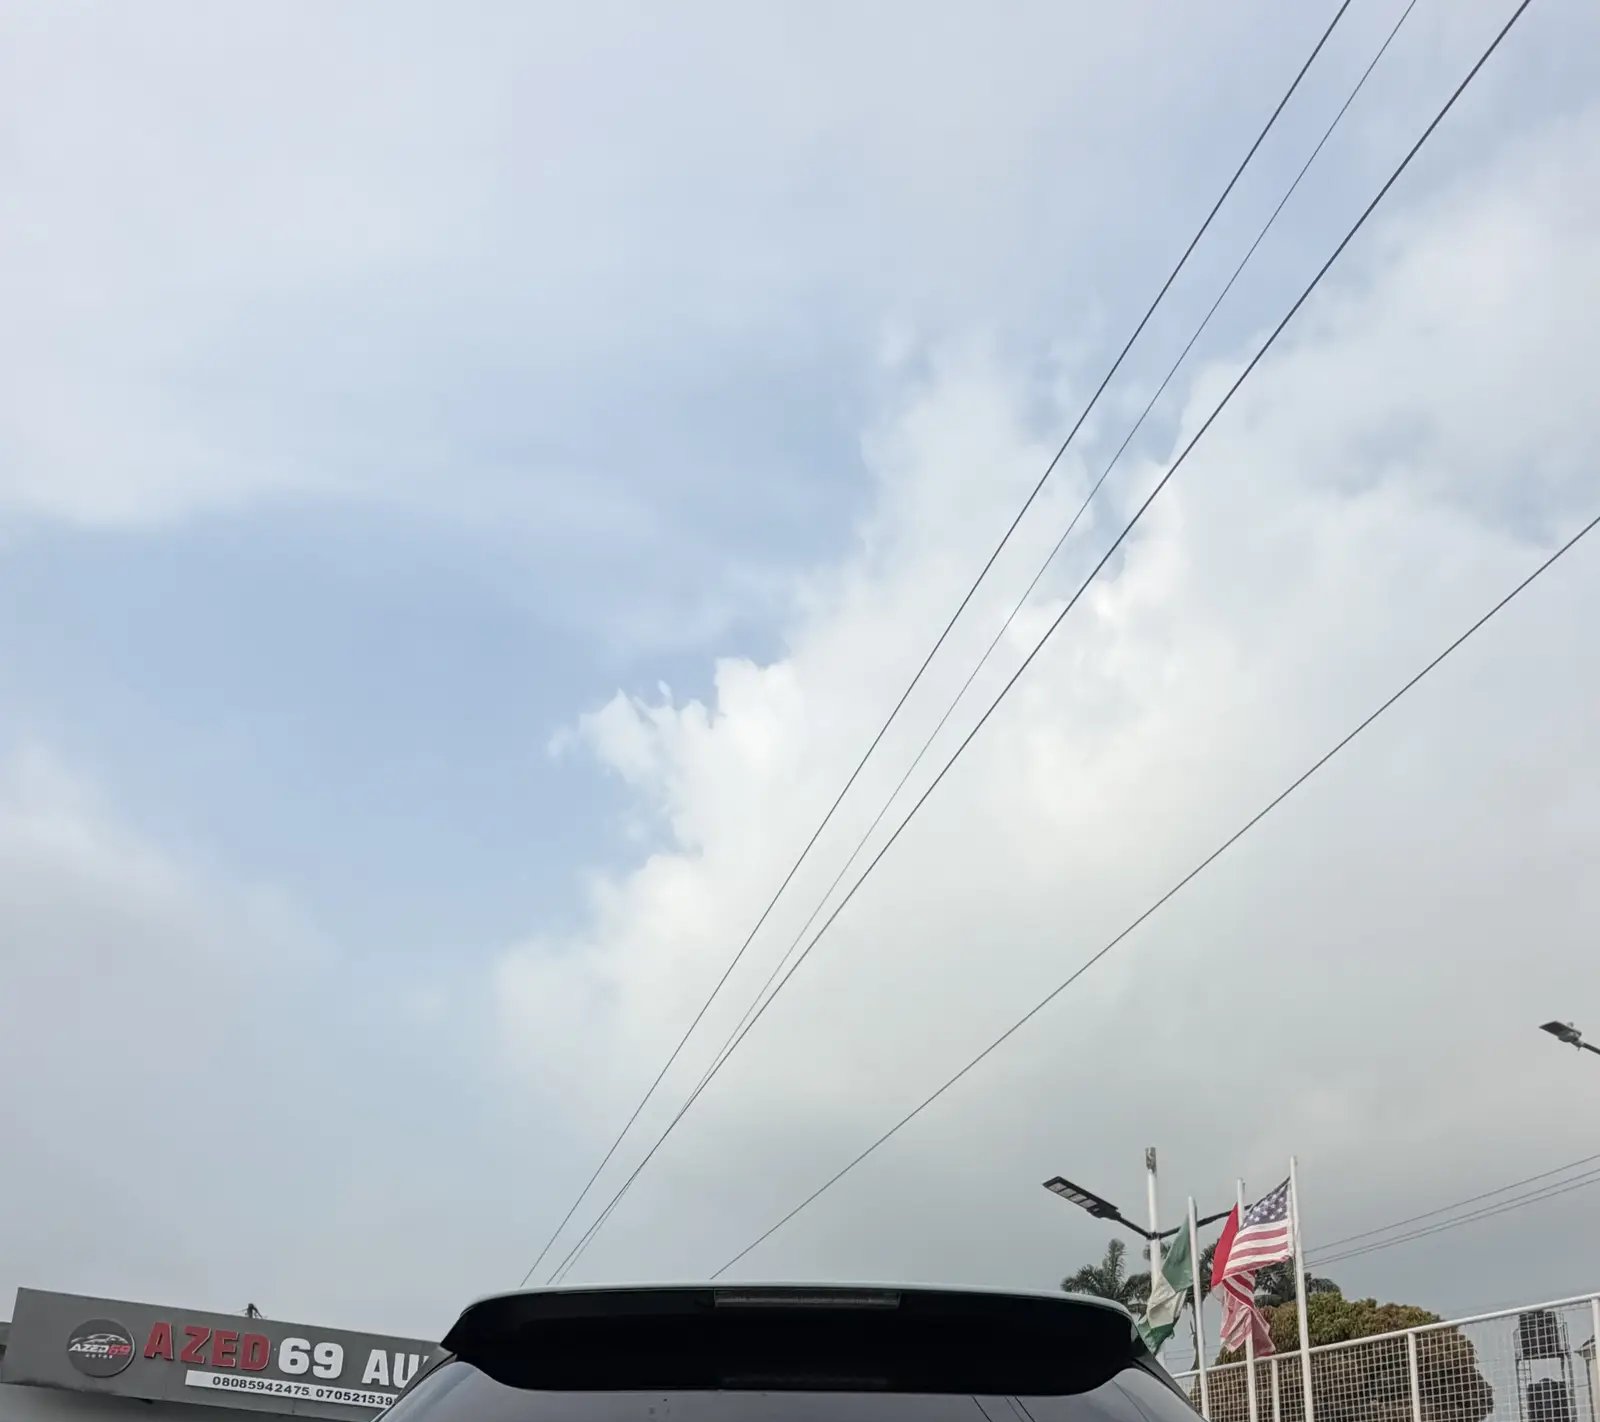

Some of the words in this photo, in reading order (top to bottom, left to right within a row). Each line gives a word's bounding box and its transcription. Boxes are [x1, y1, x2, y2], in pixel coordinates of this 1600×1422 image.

[144, 1322, 271, 1371] AZED
[278, 1337, 344, 1379] 69
[361, 1349, 429, 1388] AU
[212, 1376, 309, 1396] 08085942475
